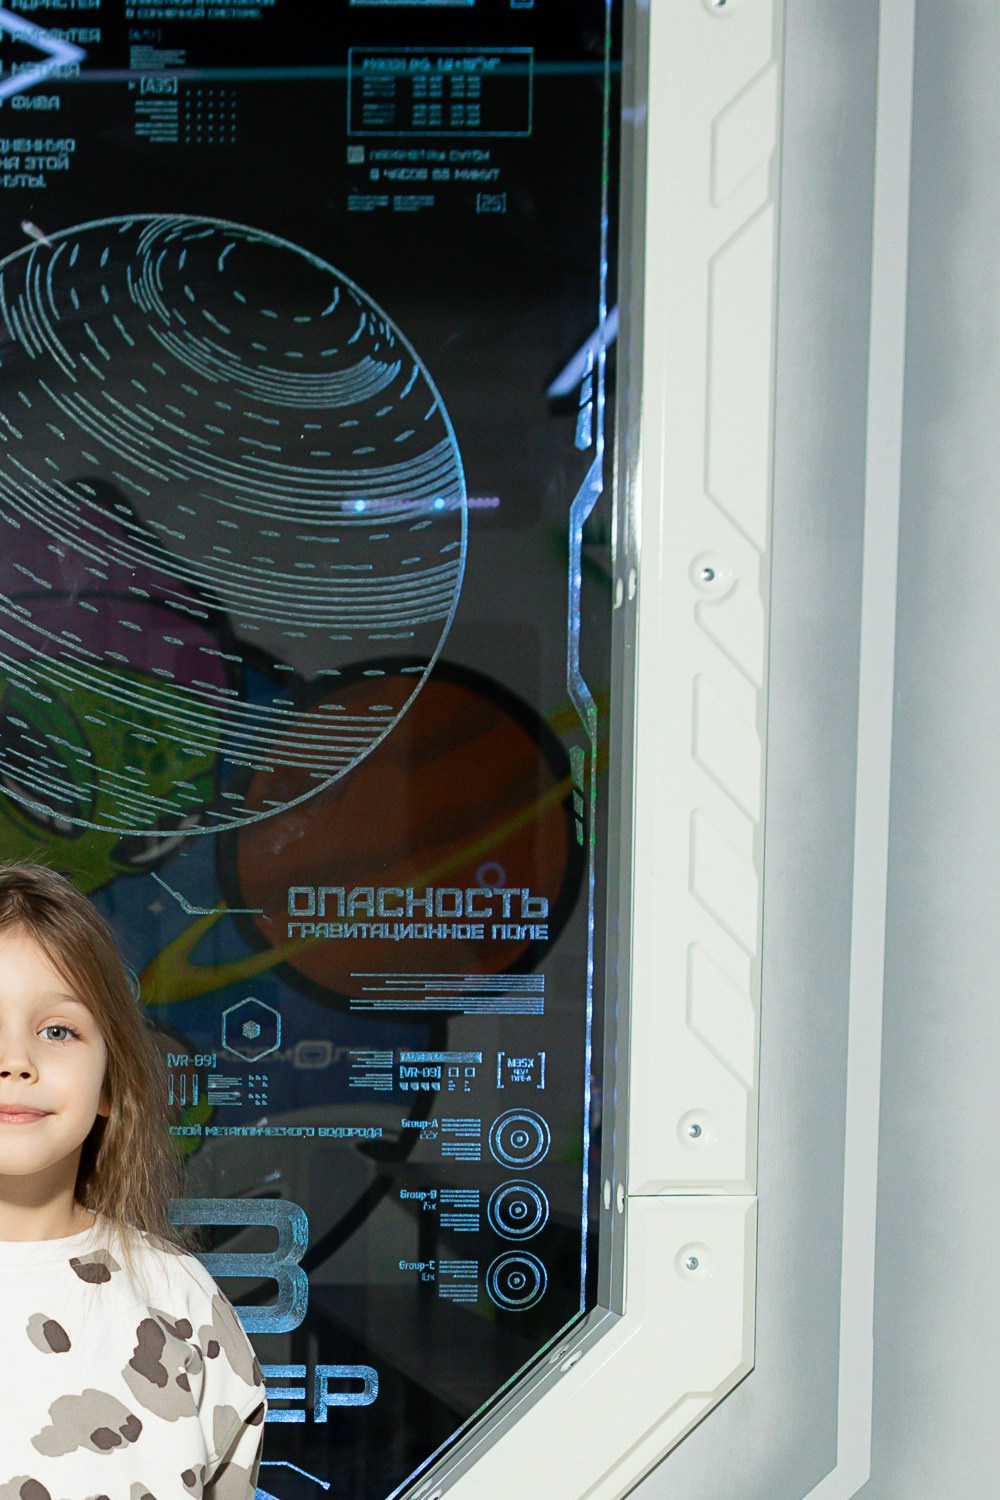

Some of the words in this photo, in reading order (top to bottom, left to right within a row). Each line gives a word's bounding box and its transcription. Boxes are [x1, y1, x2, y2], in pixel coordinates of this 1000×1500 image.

[24, 151, 70, 170] ЭТОЙ
[287, 886, 549, 918] ОПАСНОСТЬ
[287, 922, 485, 942] ГРАВИТАЦИОННОЕ
[491, 923, 549, 941] ПОЛЕ
[317, 1127, 383, 1139] ВОДОРОДА
[401, 1118, 439, 1130] Group-A
